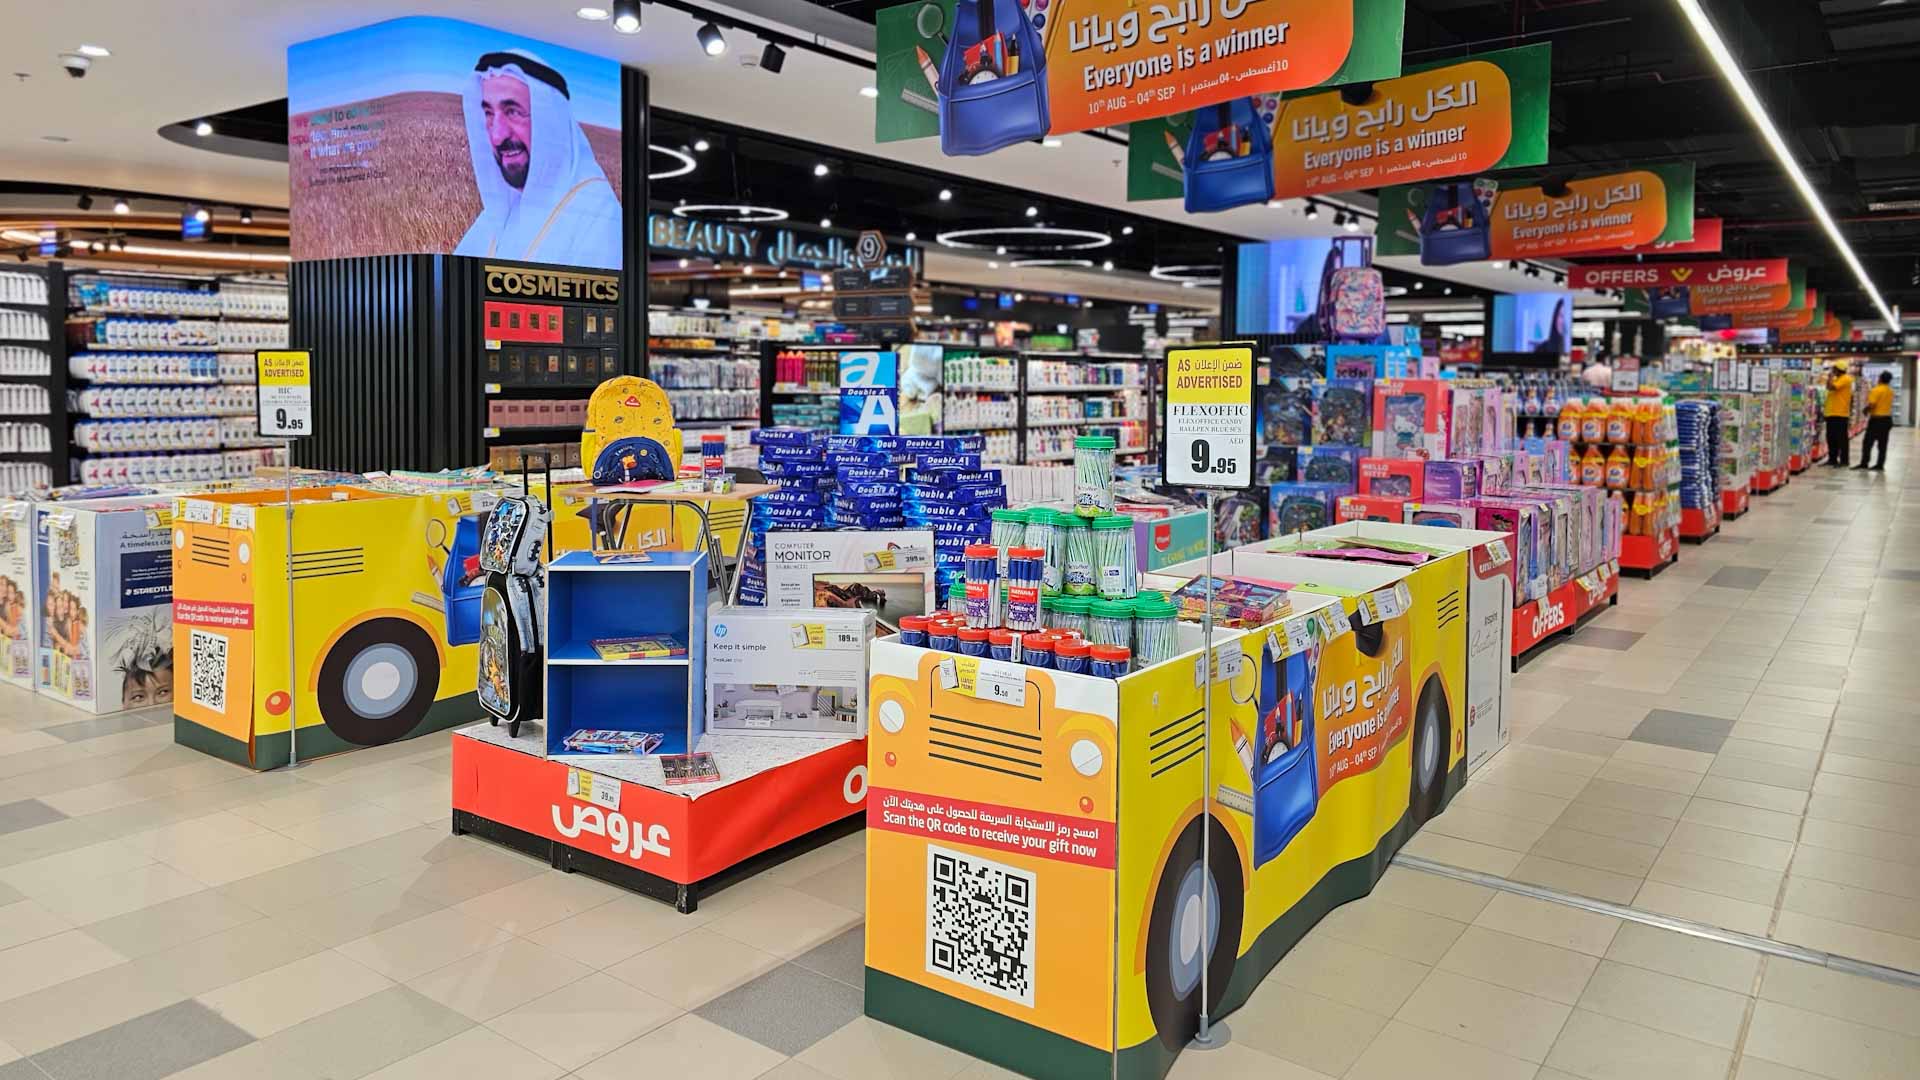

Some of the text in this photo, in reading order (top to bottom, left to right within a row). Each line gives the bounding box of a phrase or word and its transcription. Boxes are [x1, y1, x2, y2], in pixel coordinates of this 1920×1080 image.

[1147, 0, 1211, 43] رابح
[1068, 10, 1140, 53] ويانا
[1083, 21, 1290, 91] Everyone is a winner
[1275, 59, 1289, 71] 10
[1219, 73, 1230, 85] 04
[1088, 85, 1176, 114] 10th AUG 04th SEP
[1292, 79, 1477, 143] الكل رابح ويانا
[1304, 124, 1466, 171] Everyone is a winner
[1359, 166, 1374, 177] SEP
[1504, 182, 1641, 223] الكل رابح ويانا
[1512, 220, 1566, 241] Everyone
[1568, 218, 1578, 233] is
[1580, 217, 1589, 231] a
[1590, 211, 1633, 229] winner
[648, 214, 758, 257] BEAUTY
[863, 239, 876, 259] 9
[1585, 268, 1658, 284] OFFERS
[1707, 264, 1767, 283] عروض
[486, 272, 620, 301] COSMETICS
[264, 359, 272, 367] AS
[1177, 359, 1191, 372] AS
[1195, 358, 1242, 373] ضمن الإعلان
[264, 368, 305, 377] ADVERTISED
[1177, 375, 1243, 389] ADVERTISED
[853, 395, 896, 436] A
[1173, 405, 1249, 416] FLEXOFFIC
[276, 408, 304, 430] 9.95
[775, 447, 803, 455] Double
[1191, 438, 1237, 474] 9.95
[835, 455, 861, 463] Double
[927, 456, 956, 464] Double
[848, 469, 876, 477] Double
[1361, 463, 1389, 472] HELLO
[767, 478, 791, 487] ouble
[957, 473, 982, 481] Double
[762, 492, 795, 500] Double
[857, 485, 887, 494] Double
[914, 488, 956, 500] Double A
[766, 507, 816, 517] Double A
[870, 502, 897, 510] Double
[919, 504, 969, 516] Double A
[1339, 504, 1367, 512] HELLO
[127, 540, 159, 548] timeless
[775, 542, 815, 550] COMPUTER
[938, 537, 970, 546] ouble
[775, 550, 831, 563] MONITOR
[1532, 602, 1565, 639] OFFERS
[714, 625, 728, 638] hp
[713, 643, 733, 651] Keep
[741, 643, 767, 651] simple
[994, 684, 1009, 697] 9.50
[1322, 680, 1357, 720] ويانا
[1328, 718, 1376, 754] Everyone
[1376, 708, 1384, 729] is
[1337, 758, 1349, 772] AUG
[1355, 750, 1368, 766] 04th
[1368, 747, 1377, 761] SEP
[882, 795, 1099, 840] امسح رمز الاستجابة السريعة للحصول على هديتك الآن
[883, 811, 1097, 858] Scan the QR code to receive your gift now
